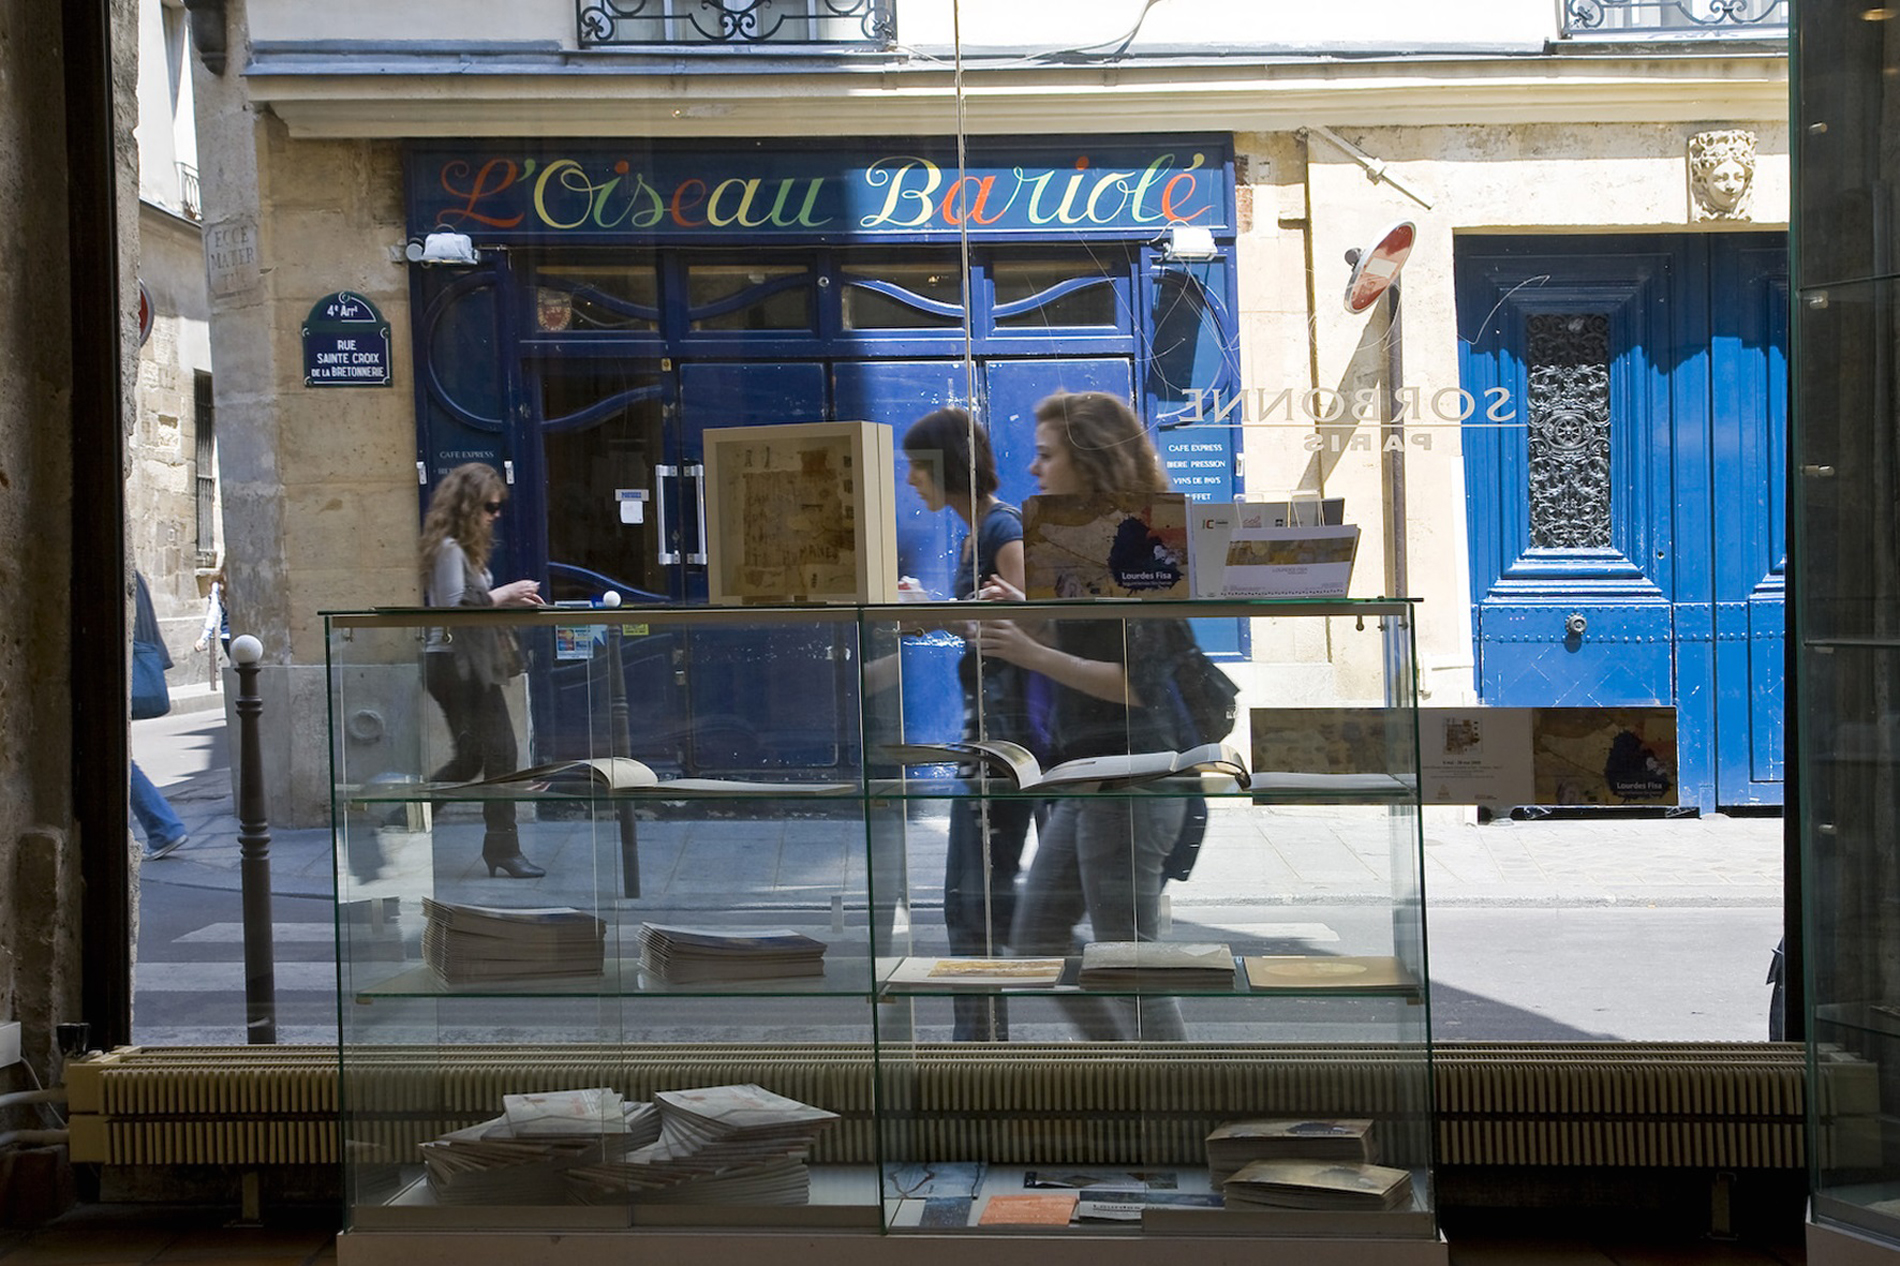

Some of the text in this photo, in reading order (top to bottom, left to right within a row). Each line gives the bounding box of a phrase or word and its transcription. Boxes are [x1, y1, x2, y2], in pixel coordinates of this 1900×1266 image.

[436, 153, 1216, 229] L'Oiseau Bariolé
[214, 226, 249, 248] ECCE
[336, 339, 357, 351] RUE
[316, 352, 380, 365] SAINTE CROIX
[311, 366, 385, 377] DE LA BRETONNERIE
[1168, 444, 1223, 452] CAFE EXPRESS
[462, 450, 495, 459] EXPRESS
[1190, 460, 1226, 469] PRESSION
[1172, 476, 1192, 485] VINS
[1192, 477, 1203, 485] DE
[1121, 571, 1172, 580] Lourdes Fisa
[1616, 781, 1663, 790] Lourdes Fisa
